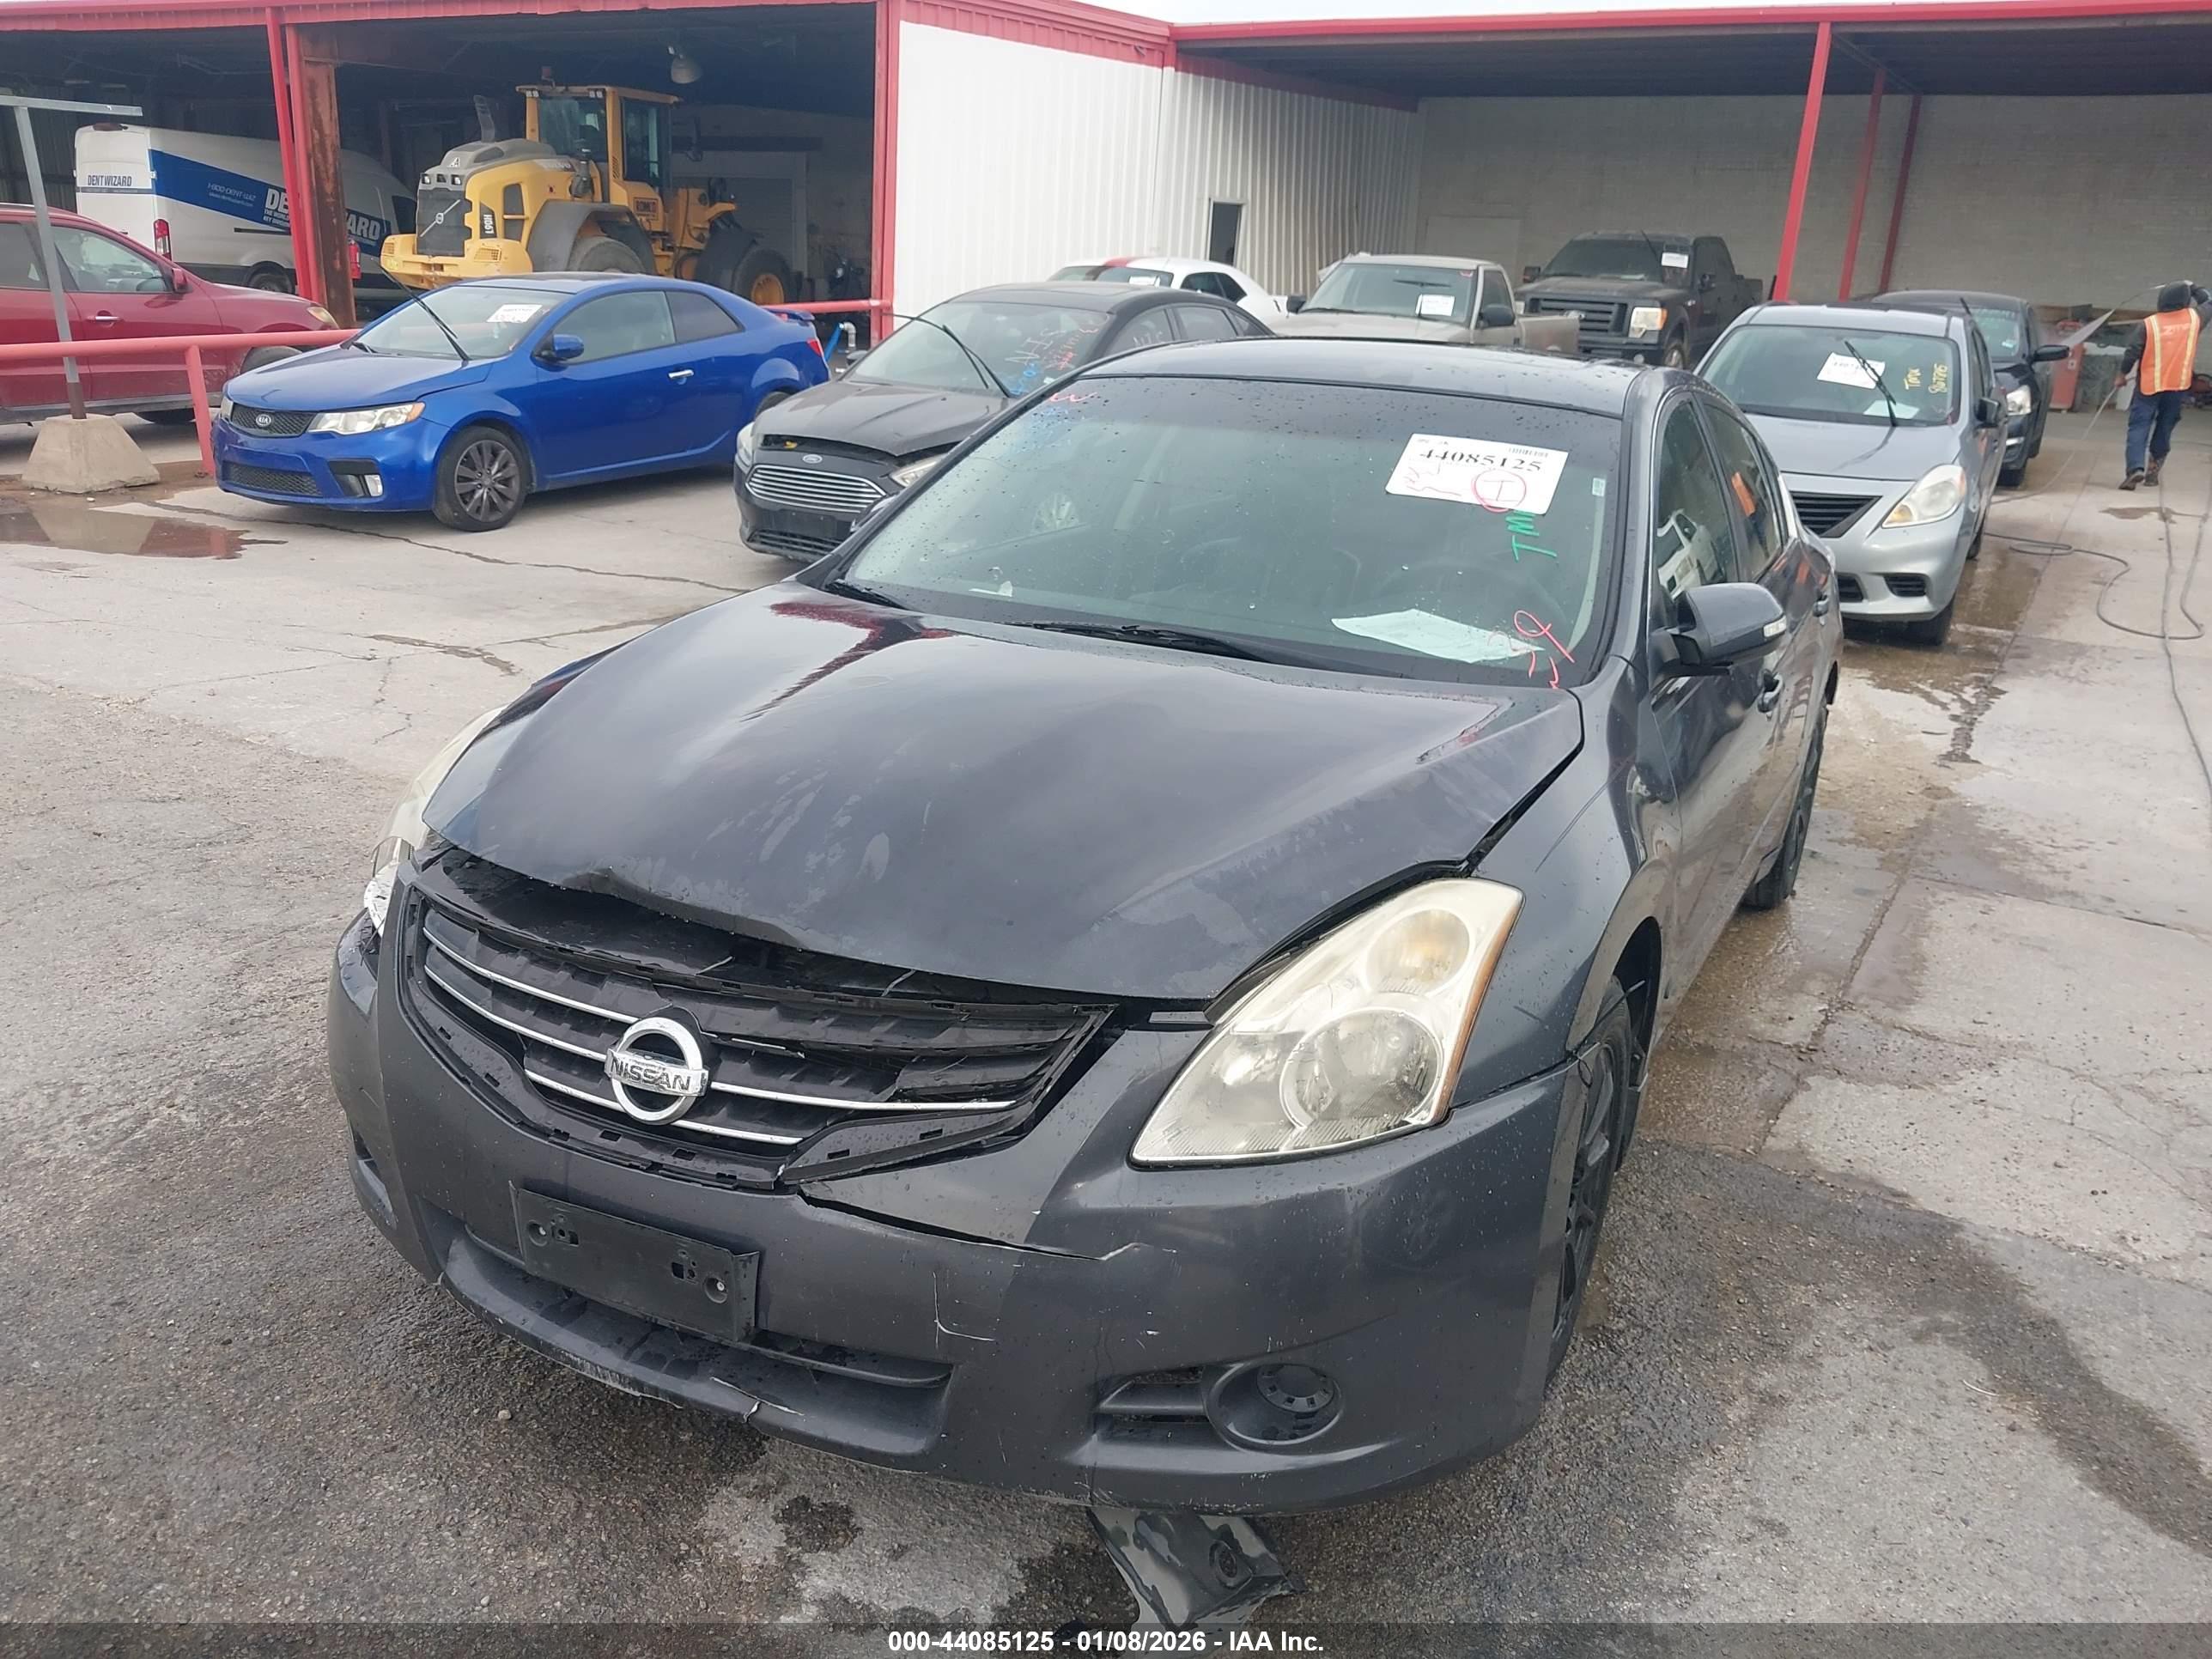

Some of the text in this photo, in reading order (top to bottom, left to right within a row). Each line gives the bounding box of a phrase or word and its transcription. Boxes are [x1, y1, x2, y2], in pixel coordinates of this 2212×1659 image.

[88, 174, 132, 187] DENT WIZARD
[264, 187, 289, 214] DE
[483, 214, 495, 234] L90H
[1419, 448, 1543, 472] 44085125
[611, 1055, 690, 1091] NISSAN
